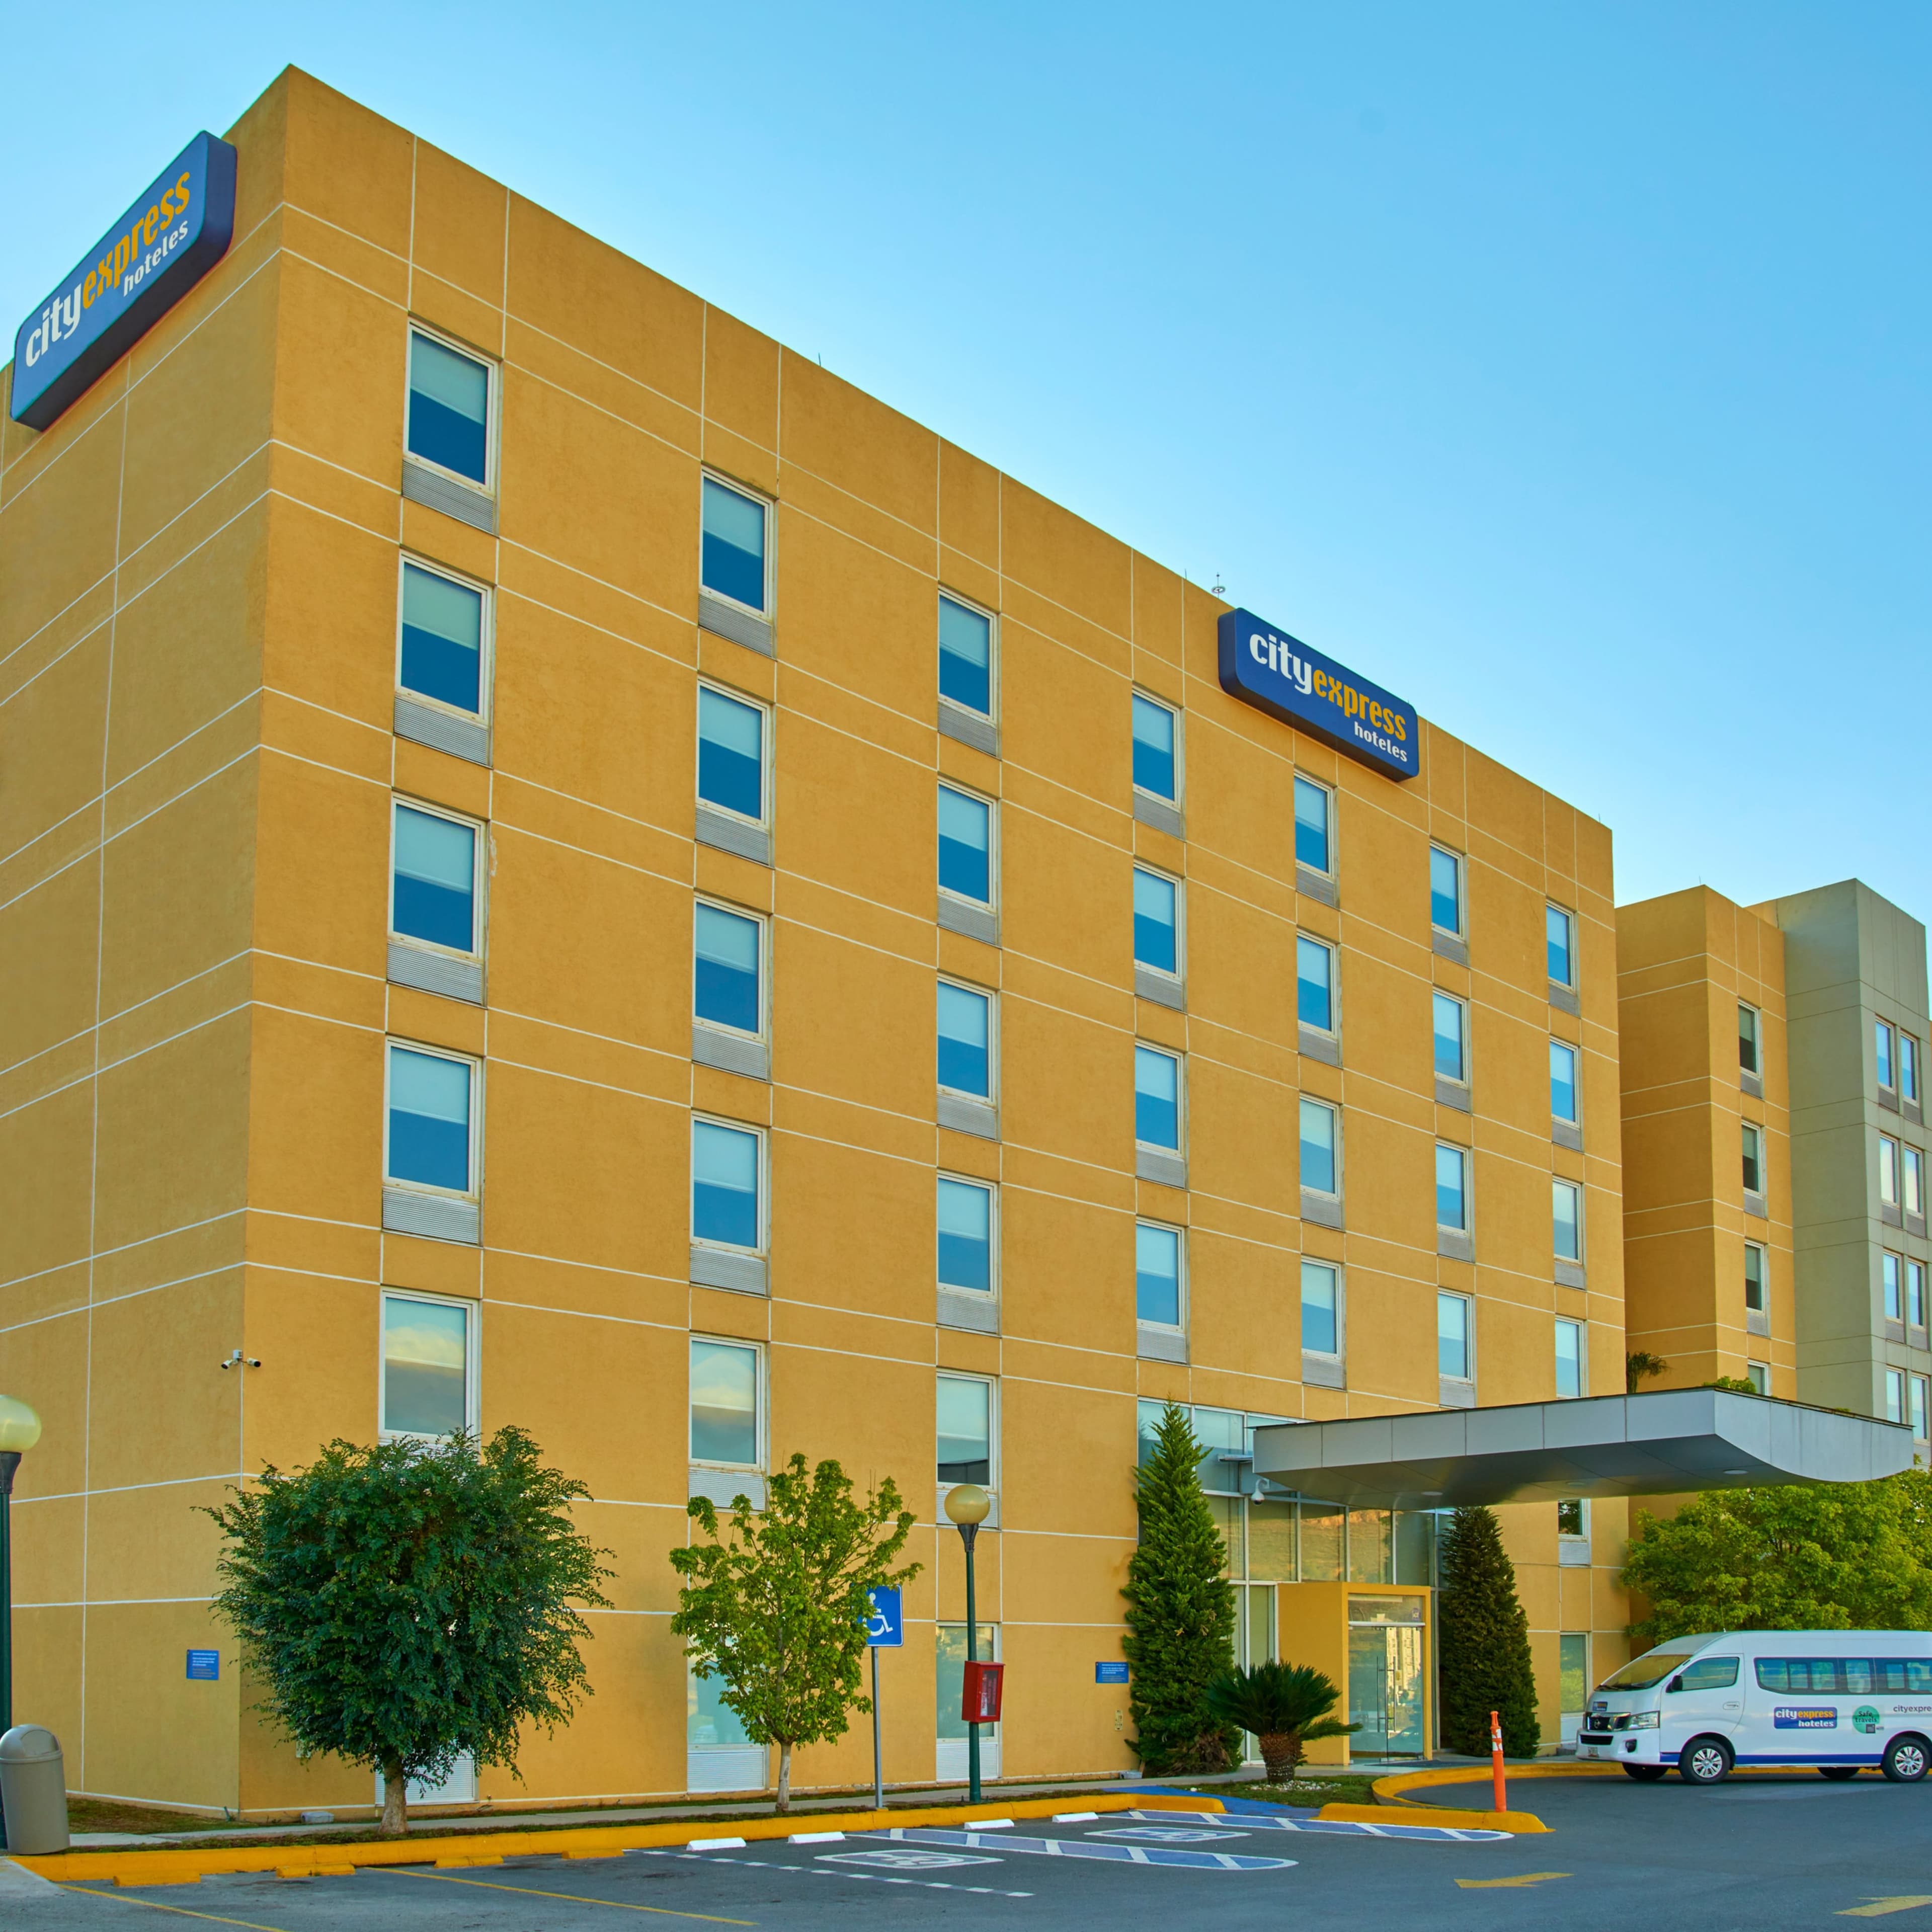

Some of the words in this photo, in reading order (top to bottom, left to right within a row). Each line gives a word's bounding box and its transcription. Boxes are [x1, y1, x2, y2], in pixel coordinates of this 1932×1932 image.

[123, 220, 188, 296] hoteles
[1354, 721, 1407, 762] hoteles
[1893, 1705, 1932, 1713] cityexpre
